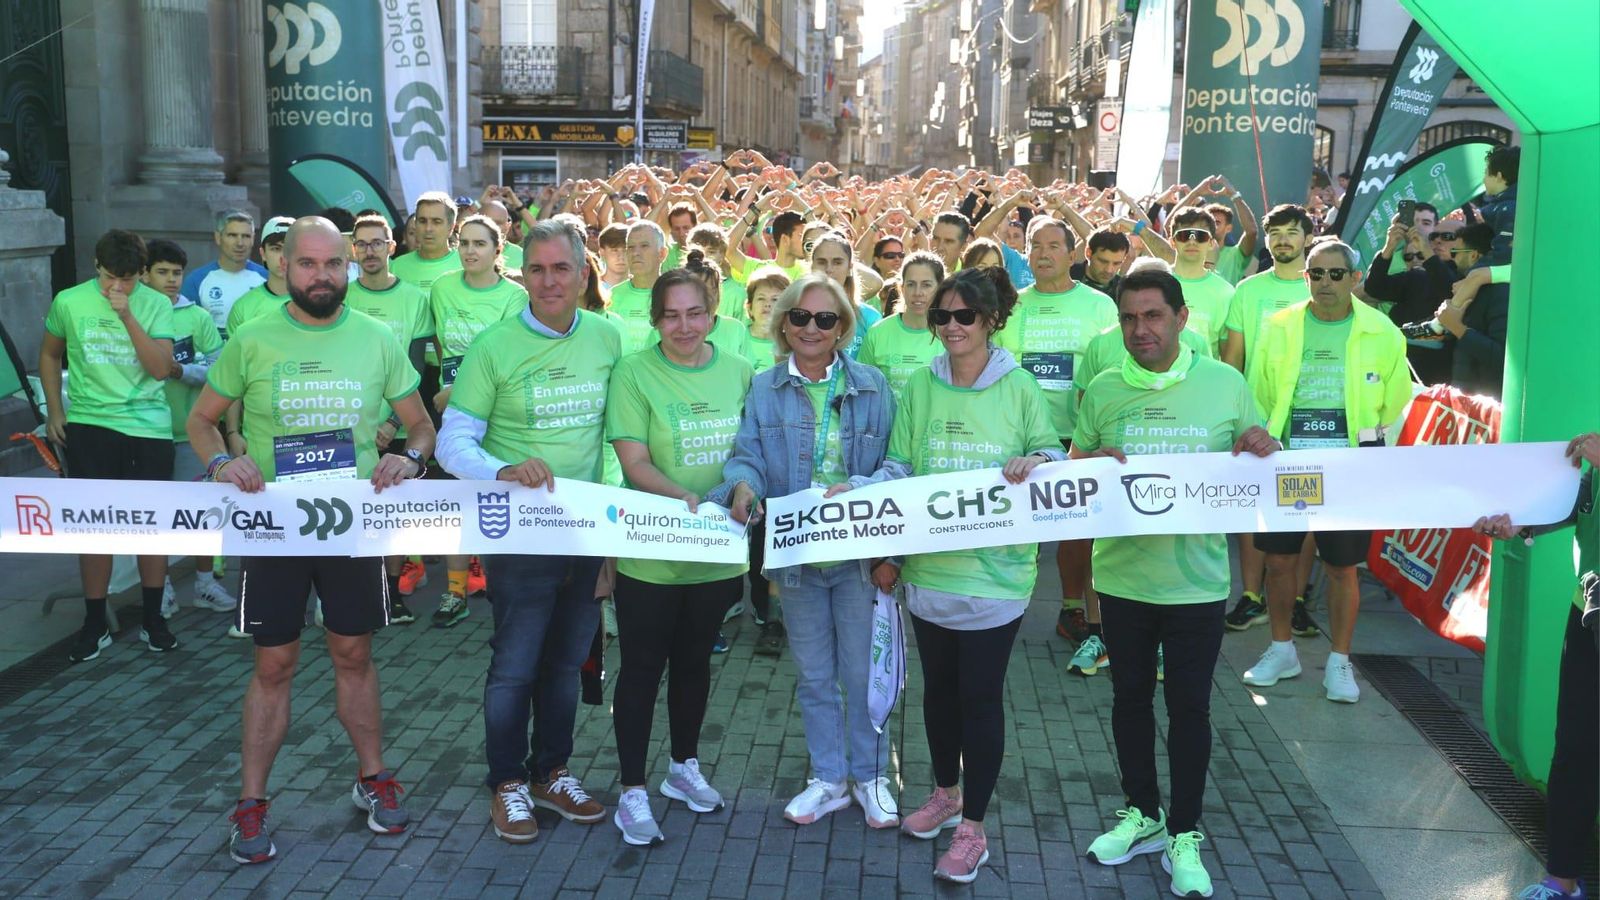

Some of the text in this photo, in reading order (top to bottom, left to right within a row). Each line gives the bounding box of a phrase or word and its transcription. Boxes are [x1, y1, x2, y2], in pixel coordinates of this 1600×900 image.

[267, 80, 373, 106] eputación
[1187, 82, 1318, 113] Deputación
[268, 107, 373, 128] ntevedra
[1030, 119, 1054, 127] Deza
[1184, 112, 1316, 137] Pontevedra
[551, 133, 606, 141] INMOBILIARIA
[1033, 365, 1061, 374] 0971
[281, 378, 362, 392] En marcha
[533, 381, 603, 398] En marcha
[279, 394, 362, 410] contra o
[535, 398, 592, 416] contra
[282, 412, 361, 427] cancro
[680, 414, 742, 431] En march
[1303, 421, 1336, 431] 2668
[1125, 424, 1208, 437] En marcha
[929, 438, 1002, 455] En marcha
[1122, 441, 1189, 455] contra
[295, 448, 336, 464] 2017
[928, 455, 984, 470] contra
[1282, 477, 1317, 491] SOLAN
[1029, 477, 1099, 511] NGP
[1134, 481, 1261, 505] Mira Maruxa
[362, 499, 461, 518] Deputación
[518, 504, 563, 515] Concello
[927, 484, 1012, 521] CHS
[62, 505, 157, 525] RAMÍREZ
[363, 515, 461, 530] Pontevedra
[518, 517, 596, 529] de Pontevedra
[1032, 509, 1088, 522] Good pet food
[64, 527, 158, 535] CONSTRUCCIONES
[929, 519, 1014, 535] CONSTRUCCIONES
[626, 530, 730, 547] Miguel Domínguez
[772, 521, 905, 550] Mourente Motor
